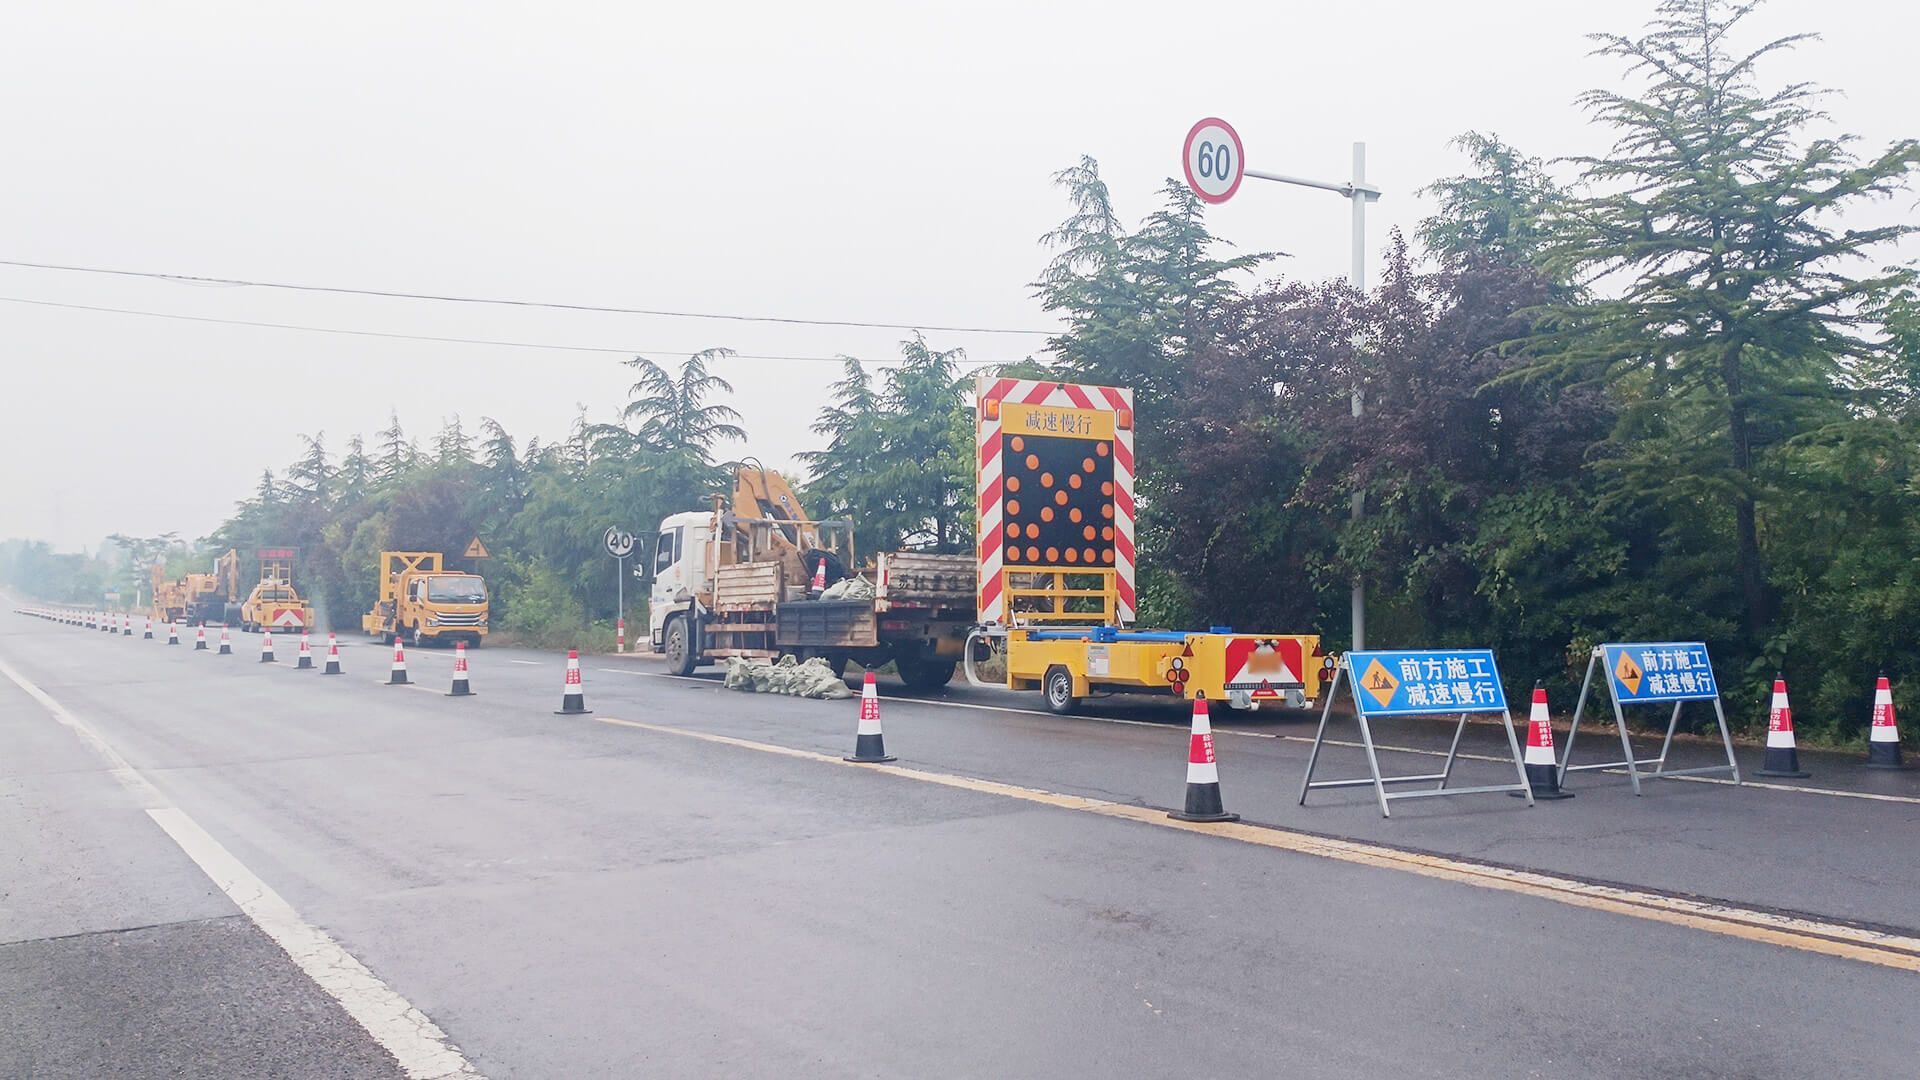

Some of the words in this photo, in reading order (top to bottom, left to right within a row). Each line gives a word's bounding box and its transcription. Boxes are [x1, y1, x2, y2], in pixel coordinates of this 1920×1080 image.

[1199, 141, 1230, 181] 60
[1026, 410, 1092, 435] 减速慢行
[610, 534, 630, 549] 40
[1398, 657, 1491, 682] 前方施工
[1641, 650, 1707, 672] 前方施工
[1405, 682, 1496, 706] 减速慢行
[1647, 672, 1711, 695] 减速慢行
